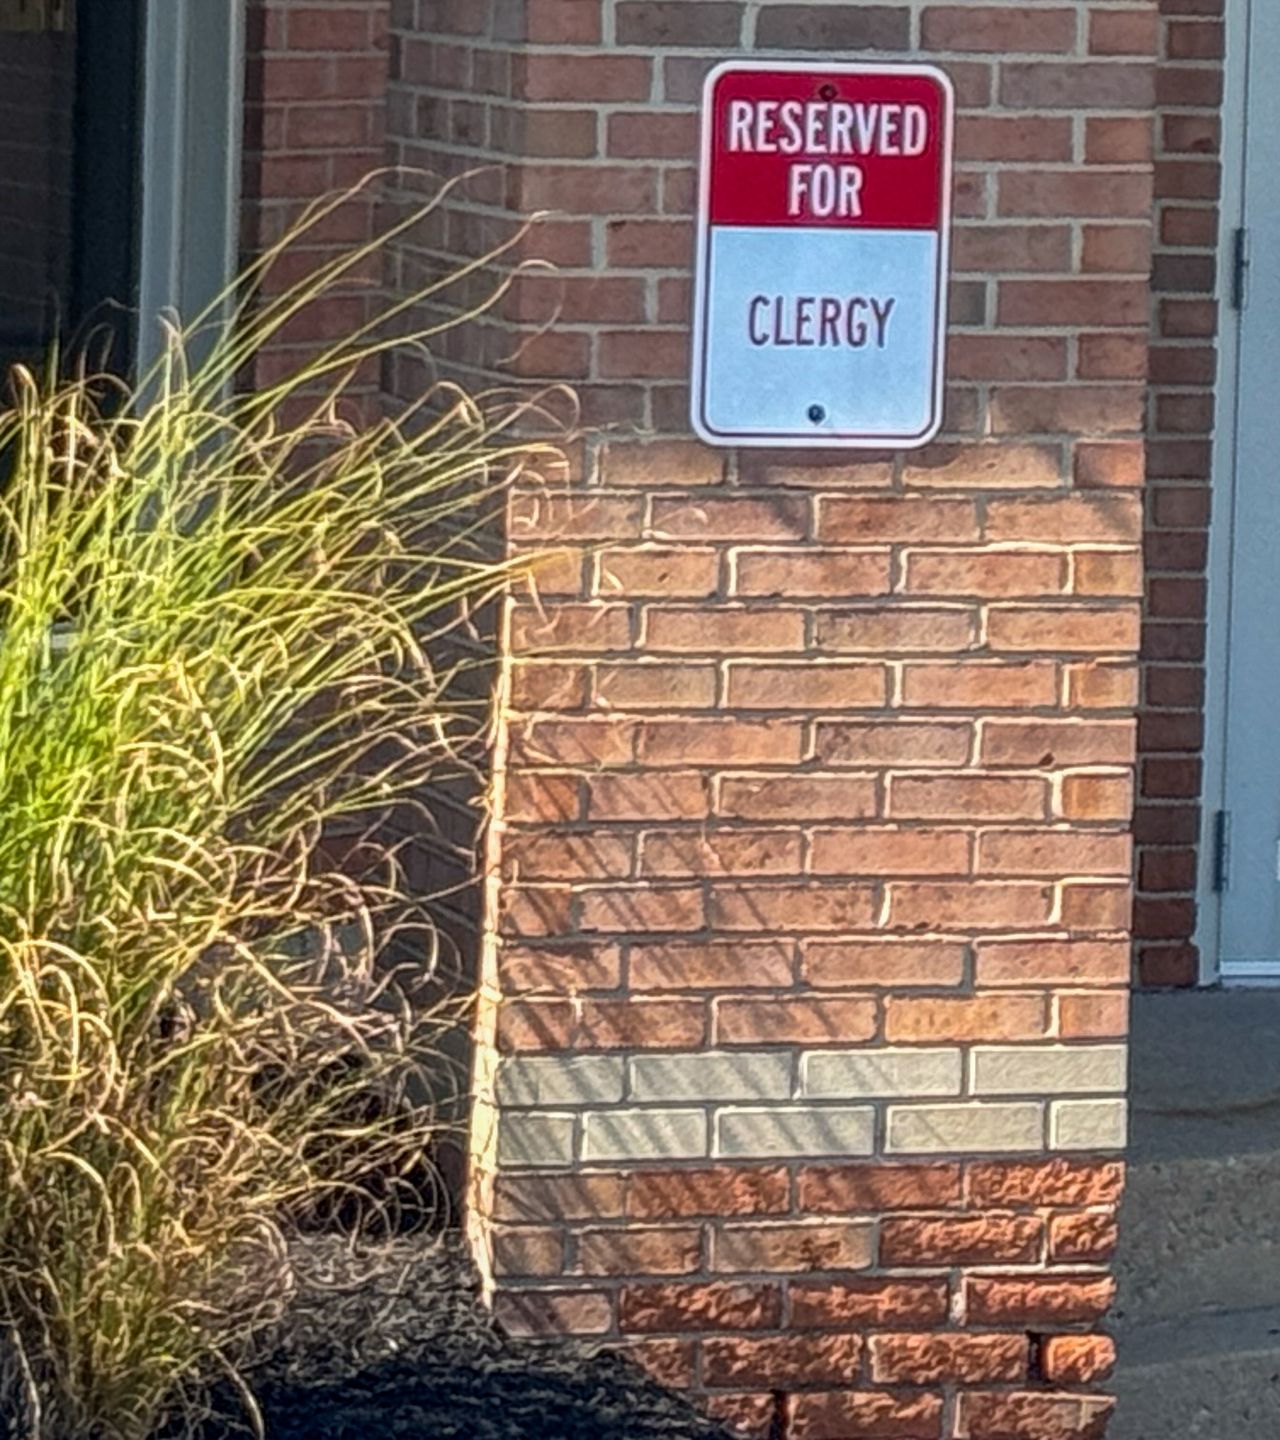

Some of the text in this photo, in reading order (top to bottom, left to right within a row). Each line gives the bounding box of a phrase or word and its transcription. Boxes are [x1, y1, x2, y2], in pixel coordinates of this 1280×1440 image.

[728, 100, 928, 156] RESERVED
[787, 162, 864, 217] FOR
[748, 294, 896, 349] CLERGY
